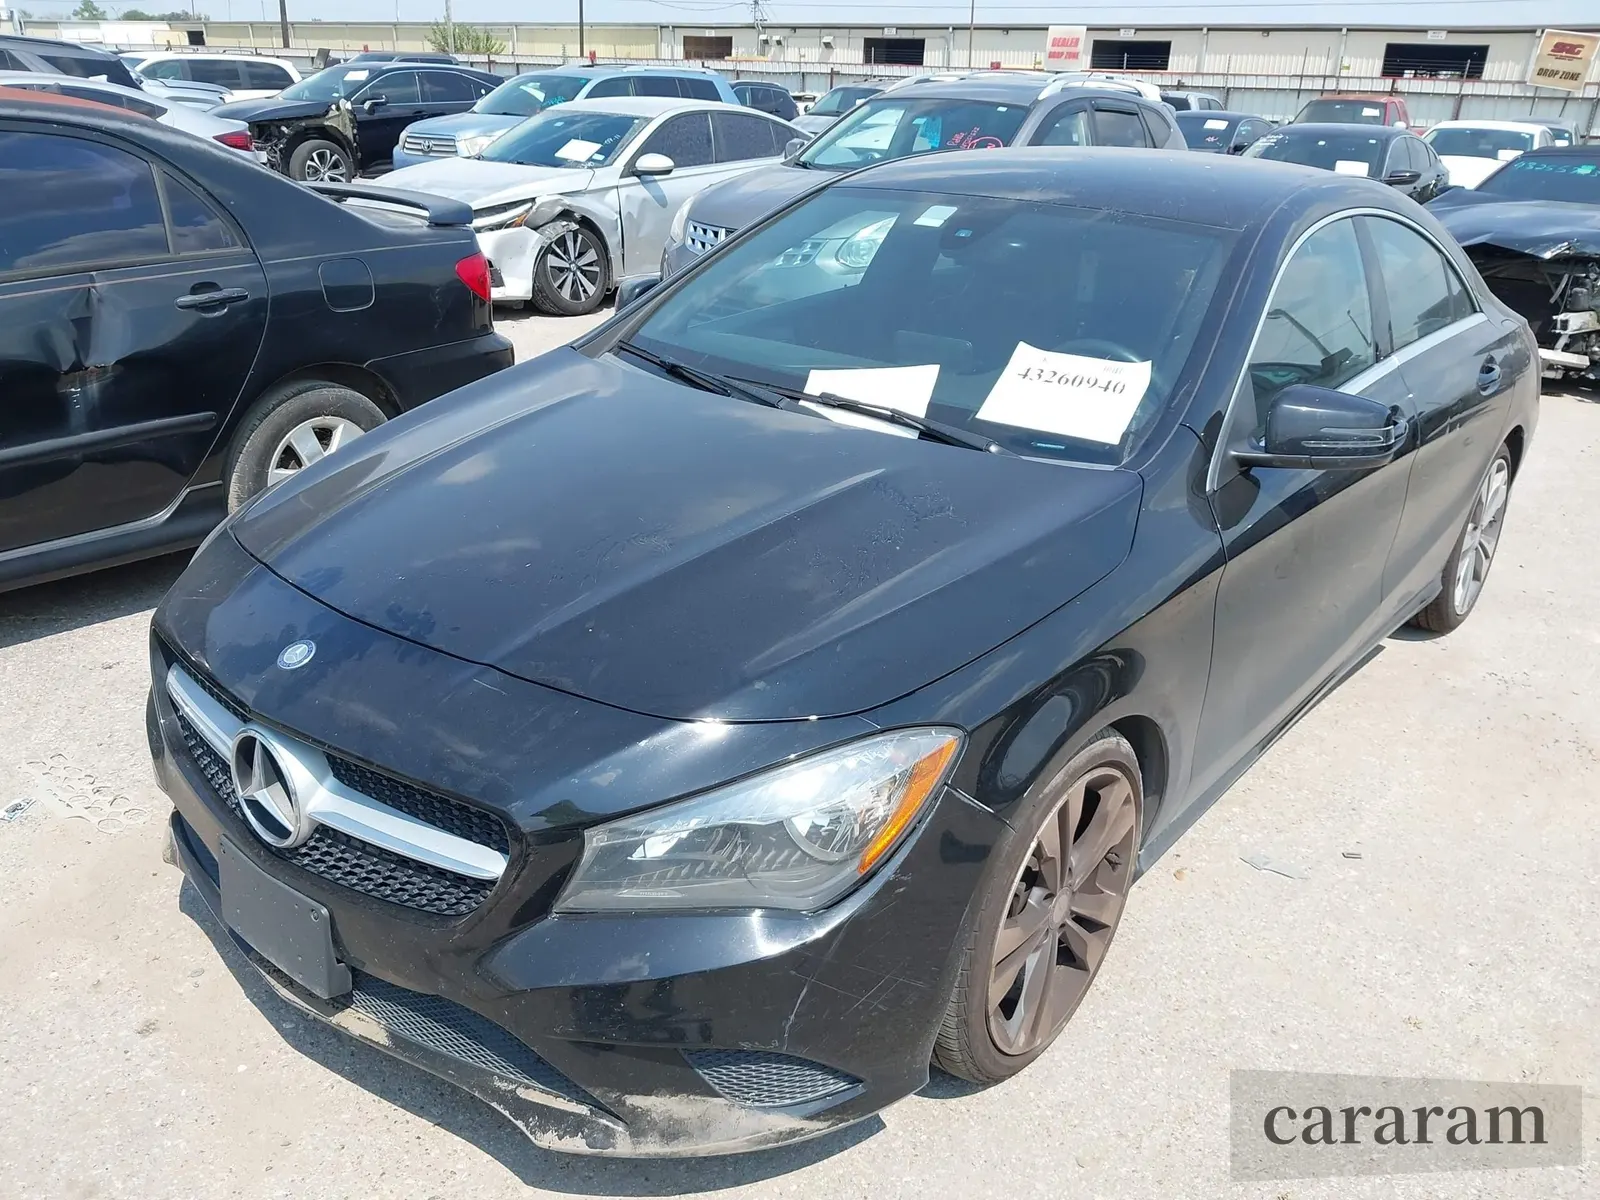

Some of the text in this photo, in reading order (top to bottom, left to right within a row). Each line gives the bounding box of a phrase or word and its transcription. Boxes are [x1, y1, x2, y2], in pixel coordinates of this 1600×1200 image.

[1051, 37, 1080, 47] DEALER
[1537, 67, 1582, 81] DROP ZONE
[1017, 367, 1125, 394] 43260940
